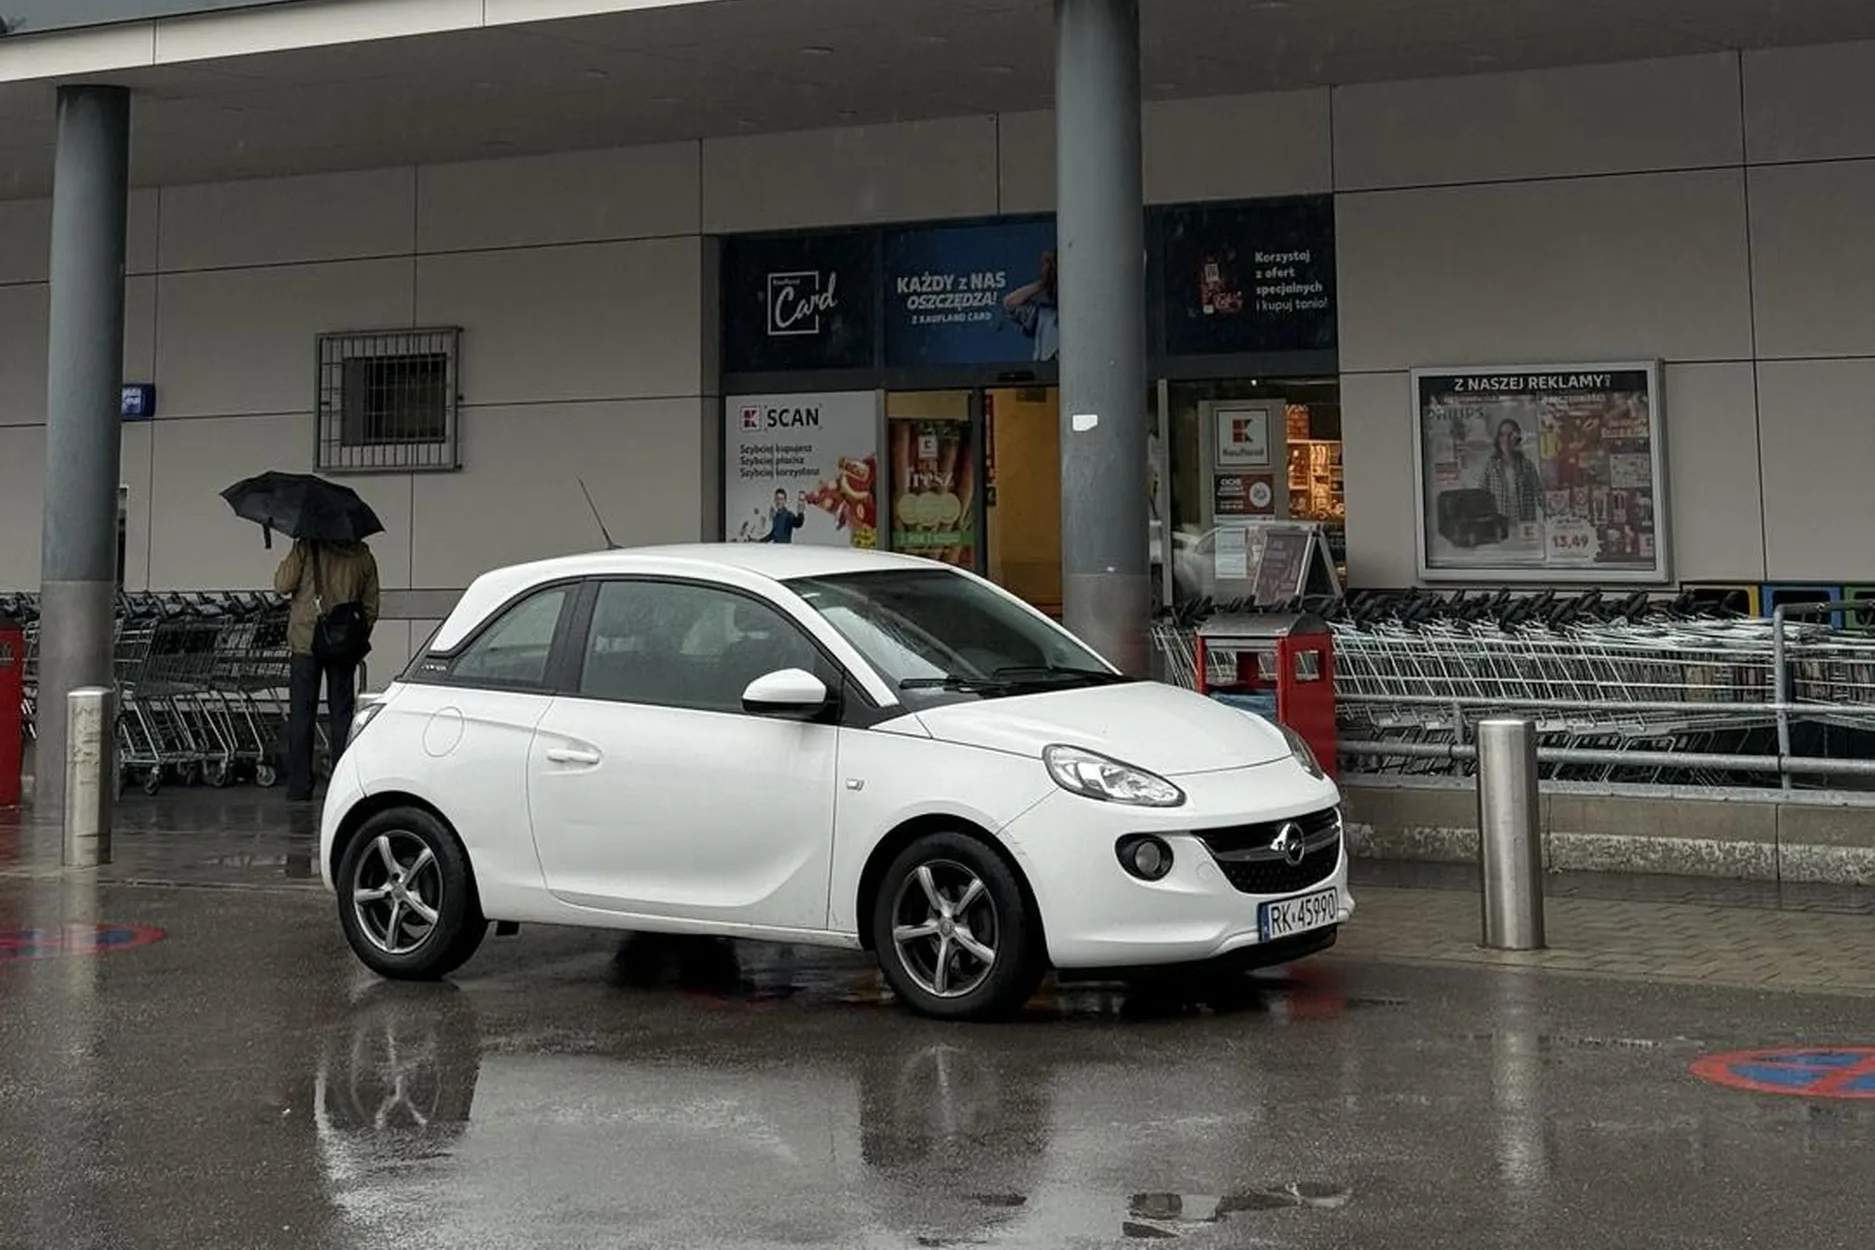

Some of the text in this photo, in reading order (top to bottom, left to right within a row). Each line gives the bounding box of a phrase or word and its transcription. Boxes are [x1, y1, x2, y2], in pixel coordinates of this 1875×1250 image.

[1254, 250, 1310, 264] Korzystaj
[1264, 266, 1295, 279] ofert
[897, 271, 954, 294] KAŻDY
[971, 271, 1006, 290] NAS
[1256, 281, 1324, 297] specjalnych
[775, 271, 838, 329] Card
[907, 291, 997, 311] OSZCZĘDZA!
[1261, 298, 1292, 314] kupuj
[968, 311, 992, 322] CARD
[1454, 375, 1604, 392] Z NASZEJ REKLAMY
[767, 408, 819, 427] SCAN
[1553, 535, 1589, 549] 13,49
[1271, 893, 1336, 936] RK 45990
